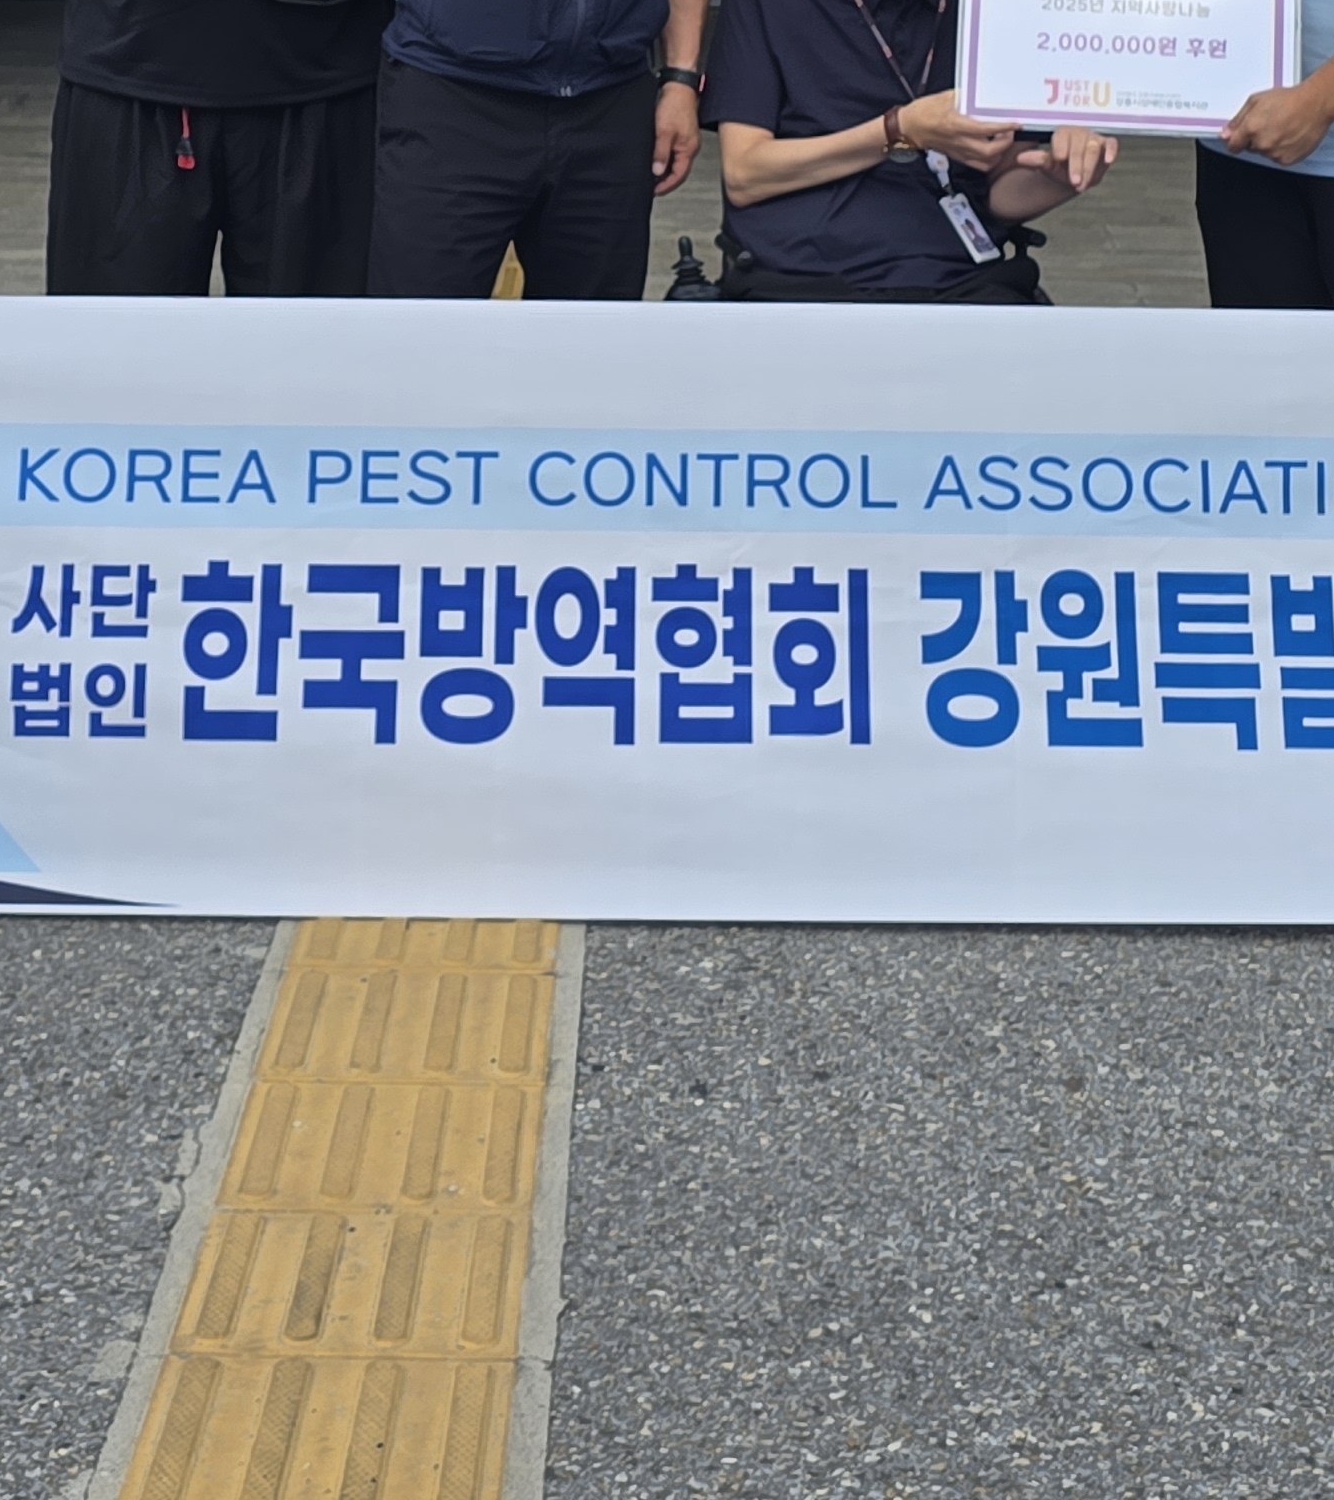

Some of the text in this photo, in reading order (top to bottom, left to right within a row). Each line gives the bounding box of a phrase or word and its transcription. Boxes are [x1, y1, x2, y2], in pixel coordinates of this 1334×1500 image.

[1186, 37, 1227, 59] 후원
[19, 448, 276, 503] KOREA
[308, 450, 497, 505] PEST
[529, 451, 897, 508] CONTROL
[12, 564, 157, 638] 사단
[181, 560, 871, 746] 한국방역협회
[11, 663, 147, 738] 법인
